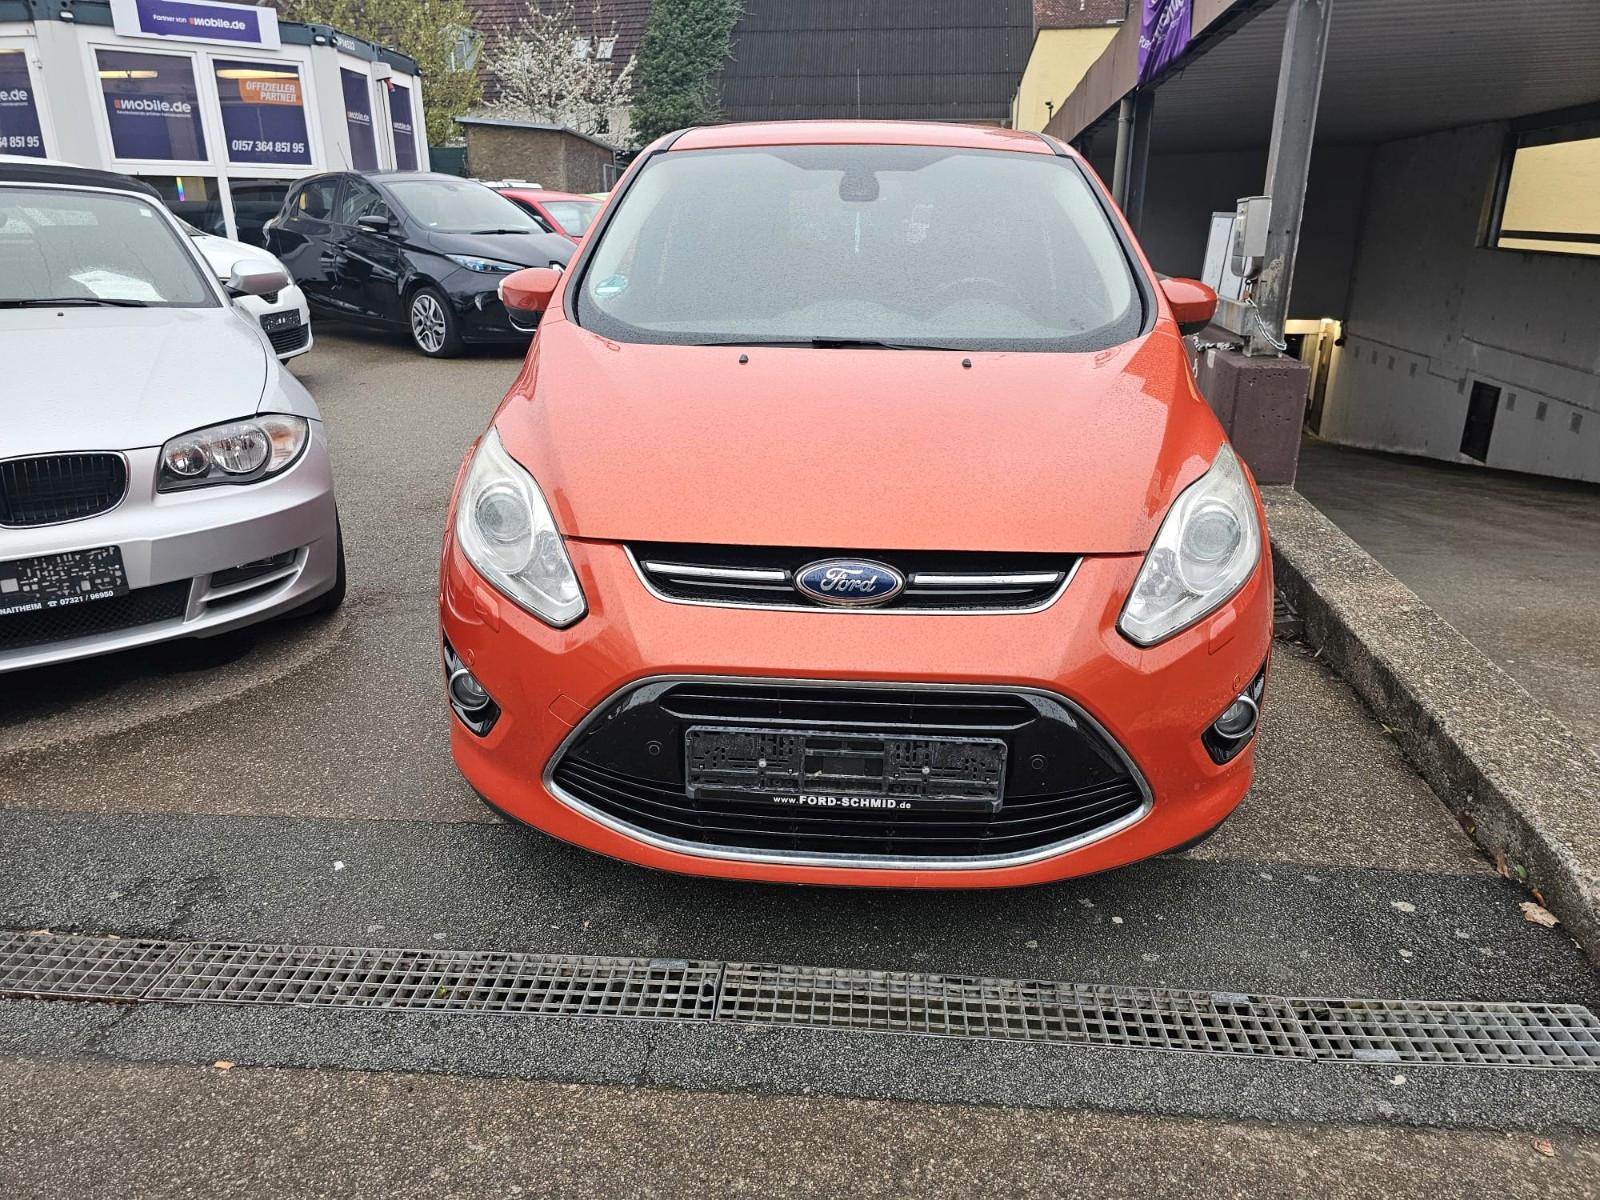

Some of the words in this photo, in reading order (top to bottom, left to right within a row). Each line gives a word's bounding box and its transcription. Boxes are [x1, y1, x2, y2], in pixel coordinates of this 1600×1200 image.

[120, 99, 191, 113] mobile.de
[9, 135, 25, 148] 851
[26, 135, 39, 148] 95
[232, 139, 253, 151] 0157
[255, 140, 273, 152] 364
[275, 141, 290, 153] 851
[292, 142, 305, 153] 95
[820, 567, 878, 592] Ford
[60, 596, 83, 606] 07321
[90, 590, 114, 600] 96950
[773, 795, 912, 809] www.FORD-SCHMID.de
